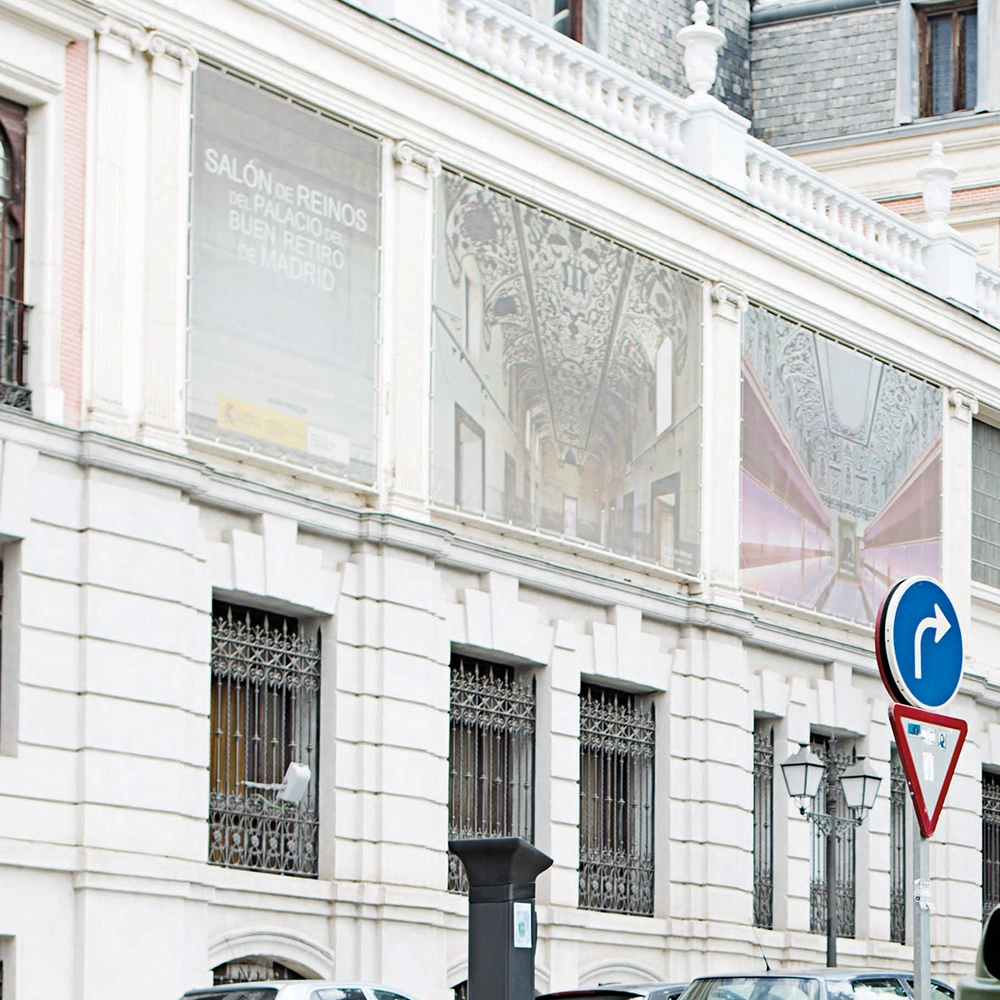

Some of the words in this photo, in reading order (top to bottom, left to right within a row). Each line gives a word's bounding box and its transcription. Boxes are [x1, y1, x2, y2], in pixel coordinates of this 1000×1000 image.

[204, 148, 273, 195] SALÓN
[275, 182, 295, 203] DE
[296, 184, 368, 232] REINOS
[228, 190, 251, 211] DEL
[253, 194, 323, 237] PALACIO
[324, 228, 346, 247] DEL
[228, 210, 276, 245] BUEN
[283, 231, 345, 270] RETIRO
[238, 244, 257, 264] DE
[260, 245, 335, 292] MADRID
